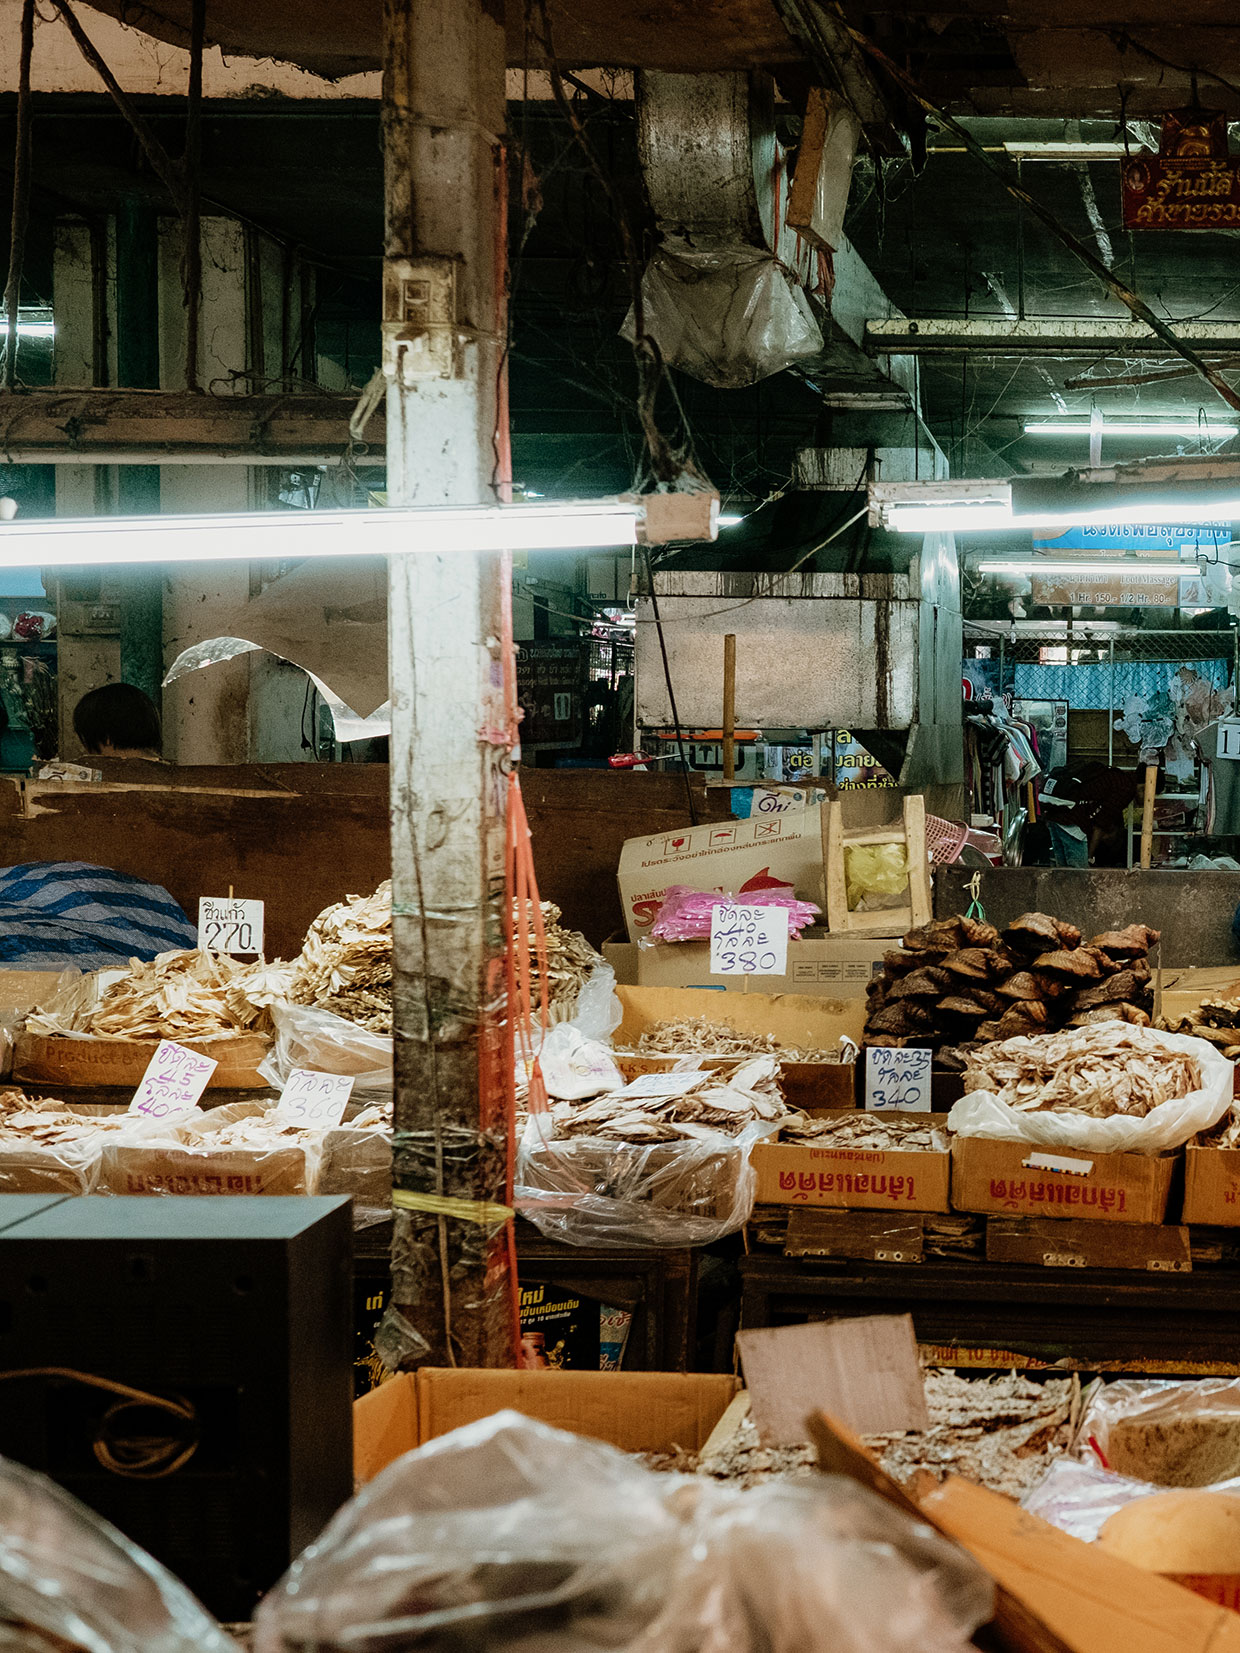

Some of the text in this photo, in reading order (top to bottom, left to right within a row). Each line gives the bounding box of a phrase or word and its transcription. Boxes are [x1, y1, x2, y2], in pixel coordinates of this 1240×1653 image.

[1078, 594, 1092, 602] Hr.
[1120, 593, 1135, 604] 1/2
[713, 931, 770, 950] โลละ
[721, 951, 777, 972] 380
[159, 1068, 195, 1086] 45
[878, 1068, 924, 1083] โลละ
[145, 1077, 194, 1100] โลละ
[872, 1088, 921, 1108] 340
[287, 1097, 343, 1119] 360
